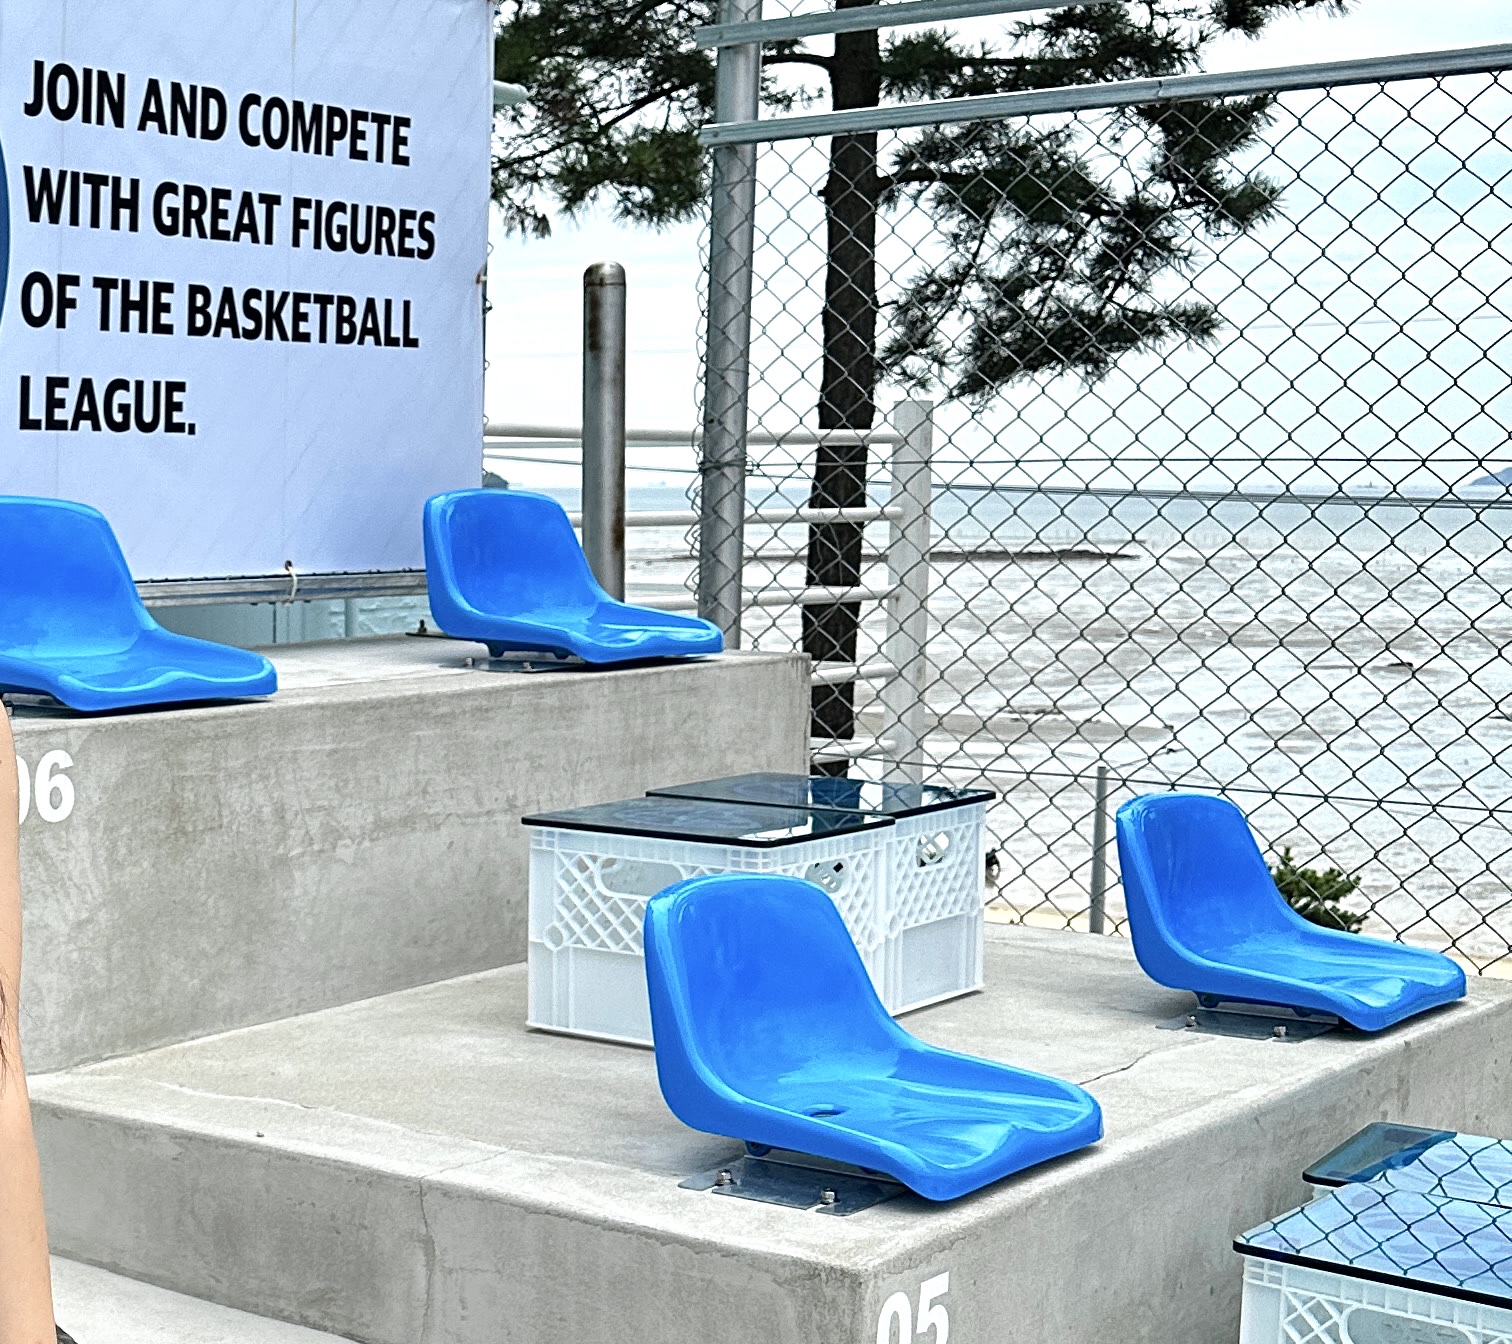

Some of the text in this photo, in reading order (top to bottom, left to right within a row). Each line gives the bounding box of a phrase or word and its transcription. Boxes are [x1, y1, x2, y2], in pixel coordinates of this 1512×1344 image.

[23, 59, 412, 167] JOIN AND COMPETE
[22, 165, 436, 260] WITH GREAT FIGURES
[20, 270, 420, 348] OF THE BASKETBALL
[19, 375, 196, 435] LEAGUE.
